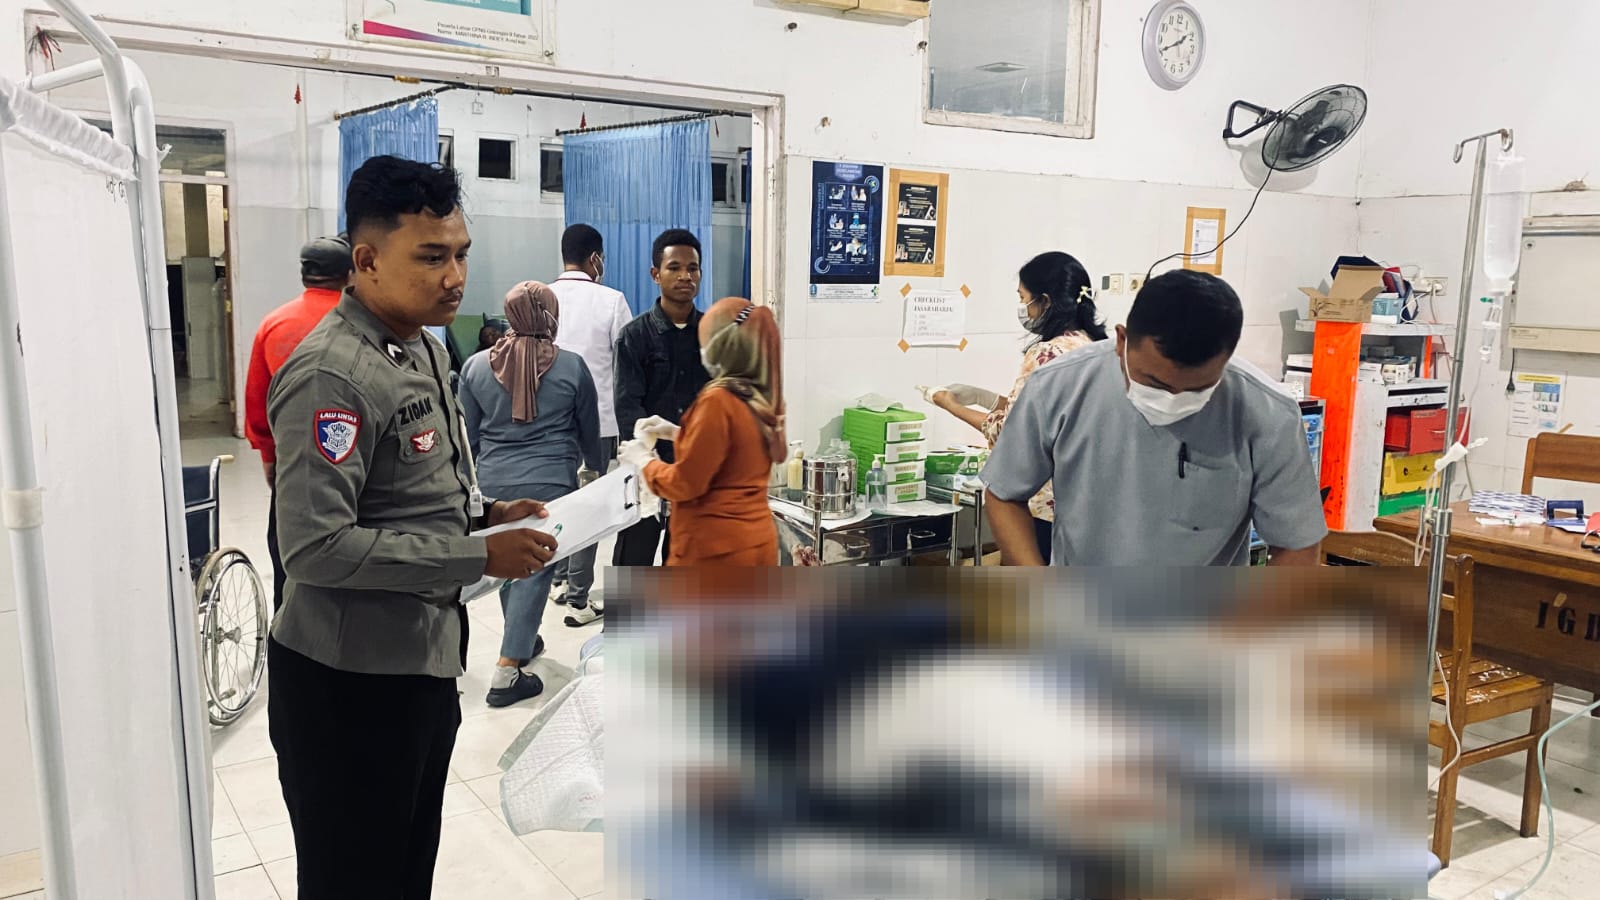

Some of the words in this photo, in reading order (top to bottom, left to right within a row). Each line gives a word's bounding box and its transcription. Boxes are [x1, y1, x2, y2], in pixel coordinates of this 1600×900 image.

[1176, 14, 1184, 24] 12
[913, 296, 945, 304] CHECKLIST
[398, 396, 433, 425] ZIDAN
[319, 412, 337, 420] LALU
[337, 413, 357, 423] LINTAS
